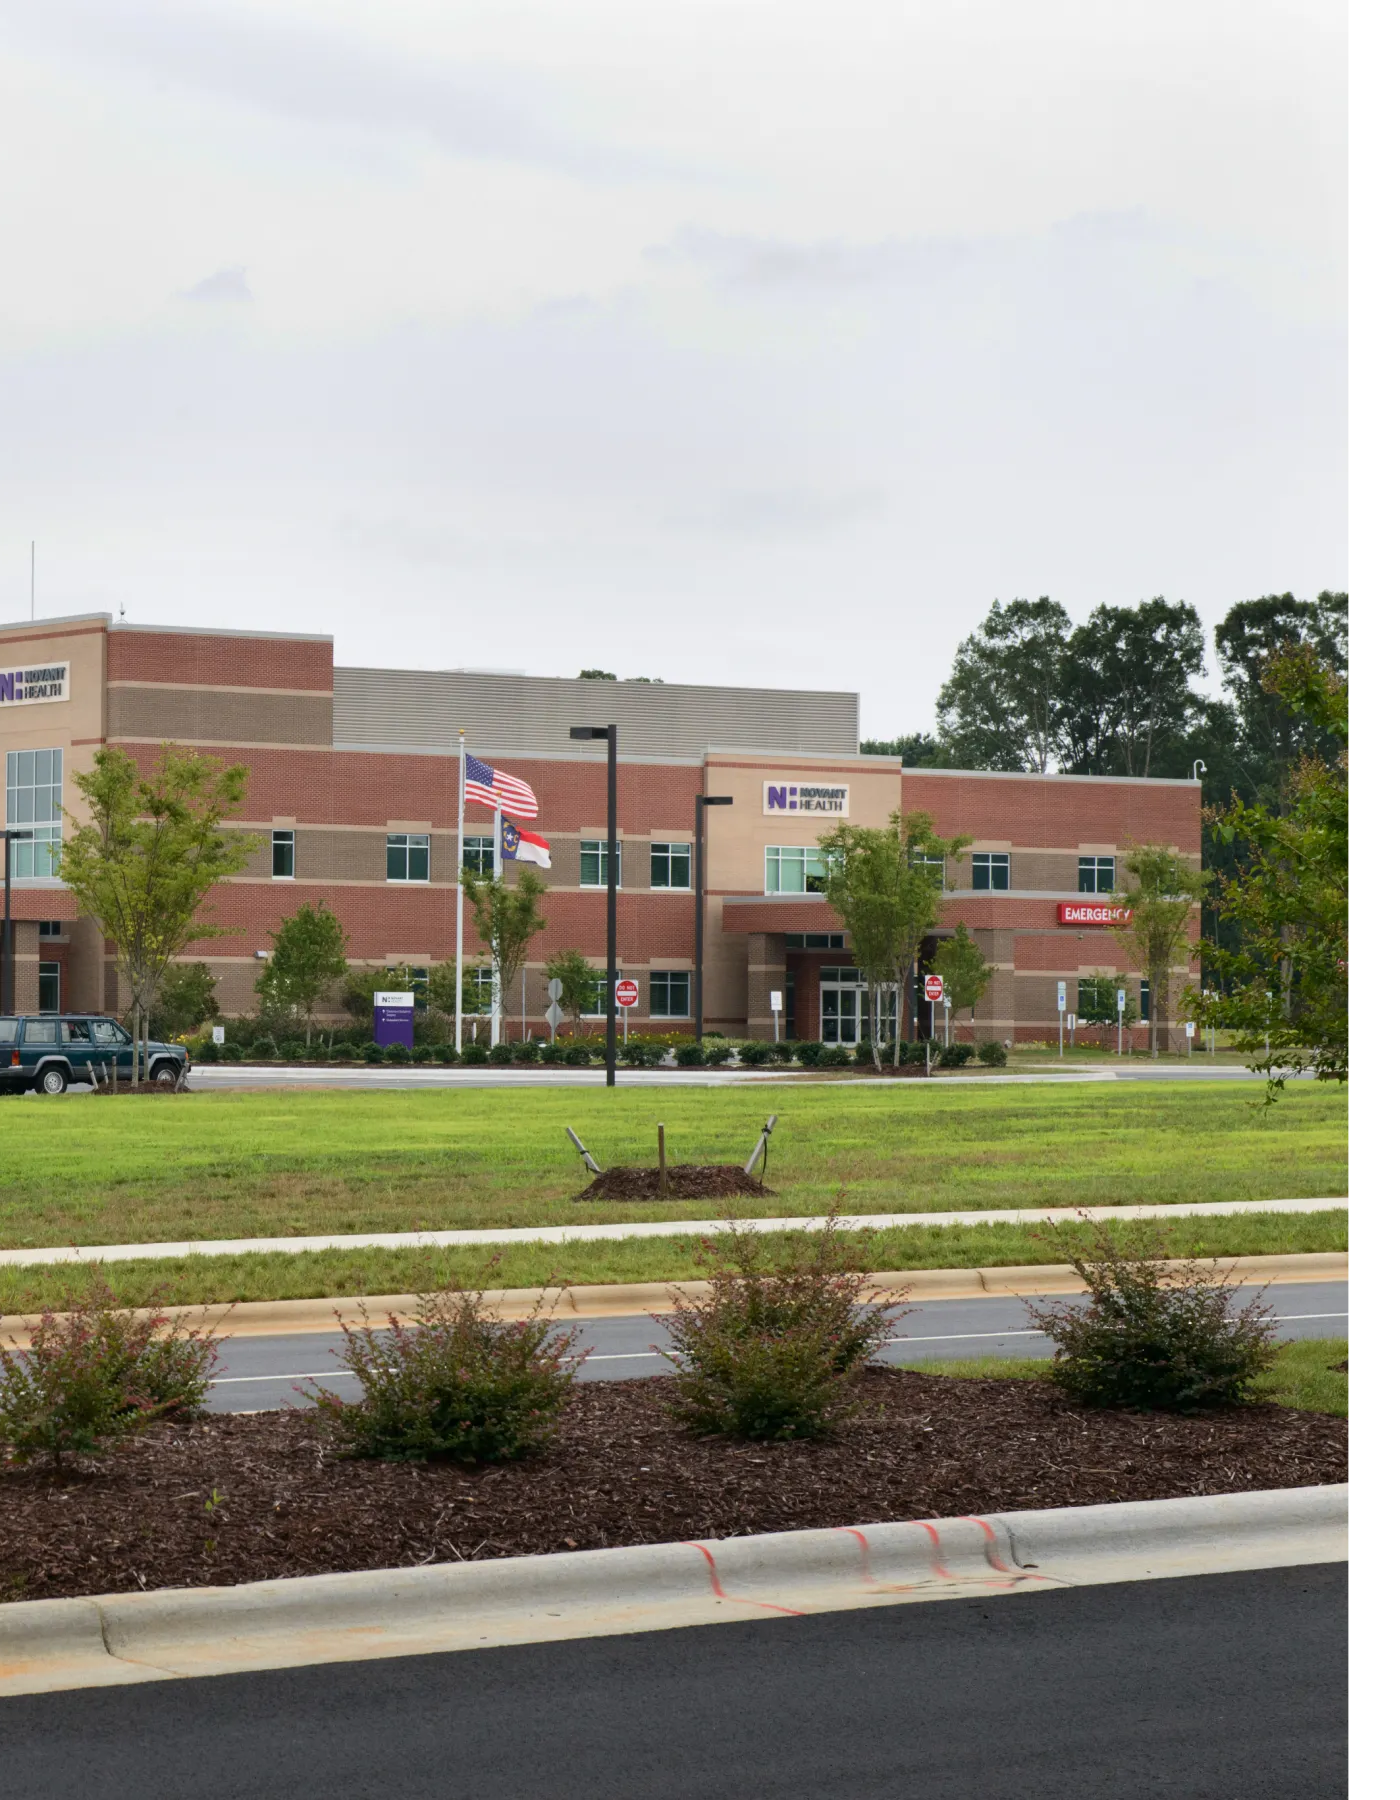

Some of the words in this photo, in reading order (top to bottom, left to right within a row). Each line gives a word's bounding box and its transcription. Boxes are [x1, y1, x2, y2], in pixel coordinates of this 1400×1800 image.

[24, 667, 66, 684] NOVANT
[24, 683, 62, 700] HEALTH
[800, 787, 847, 799] NOVANT
[800, 800, 842, 811] HEALTH
